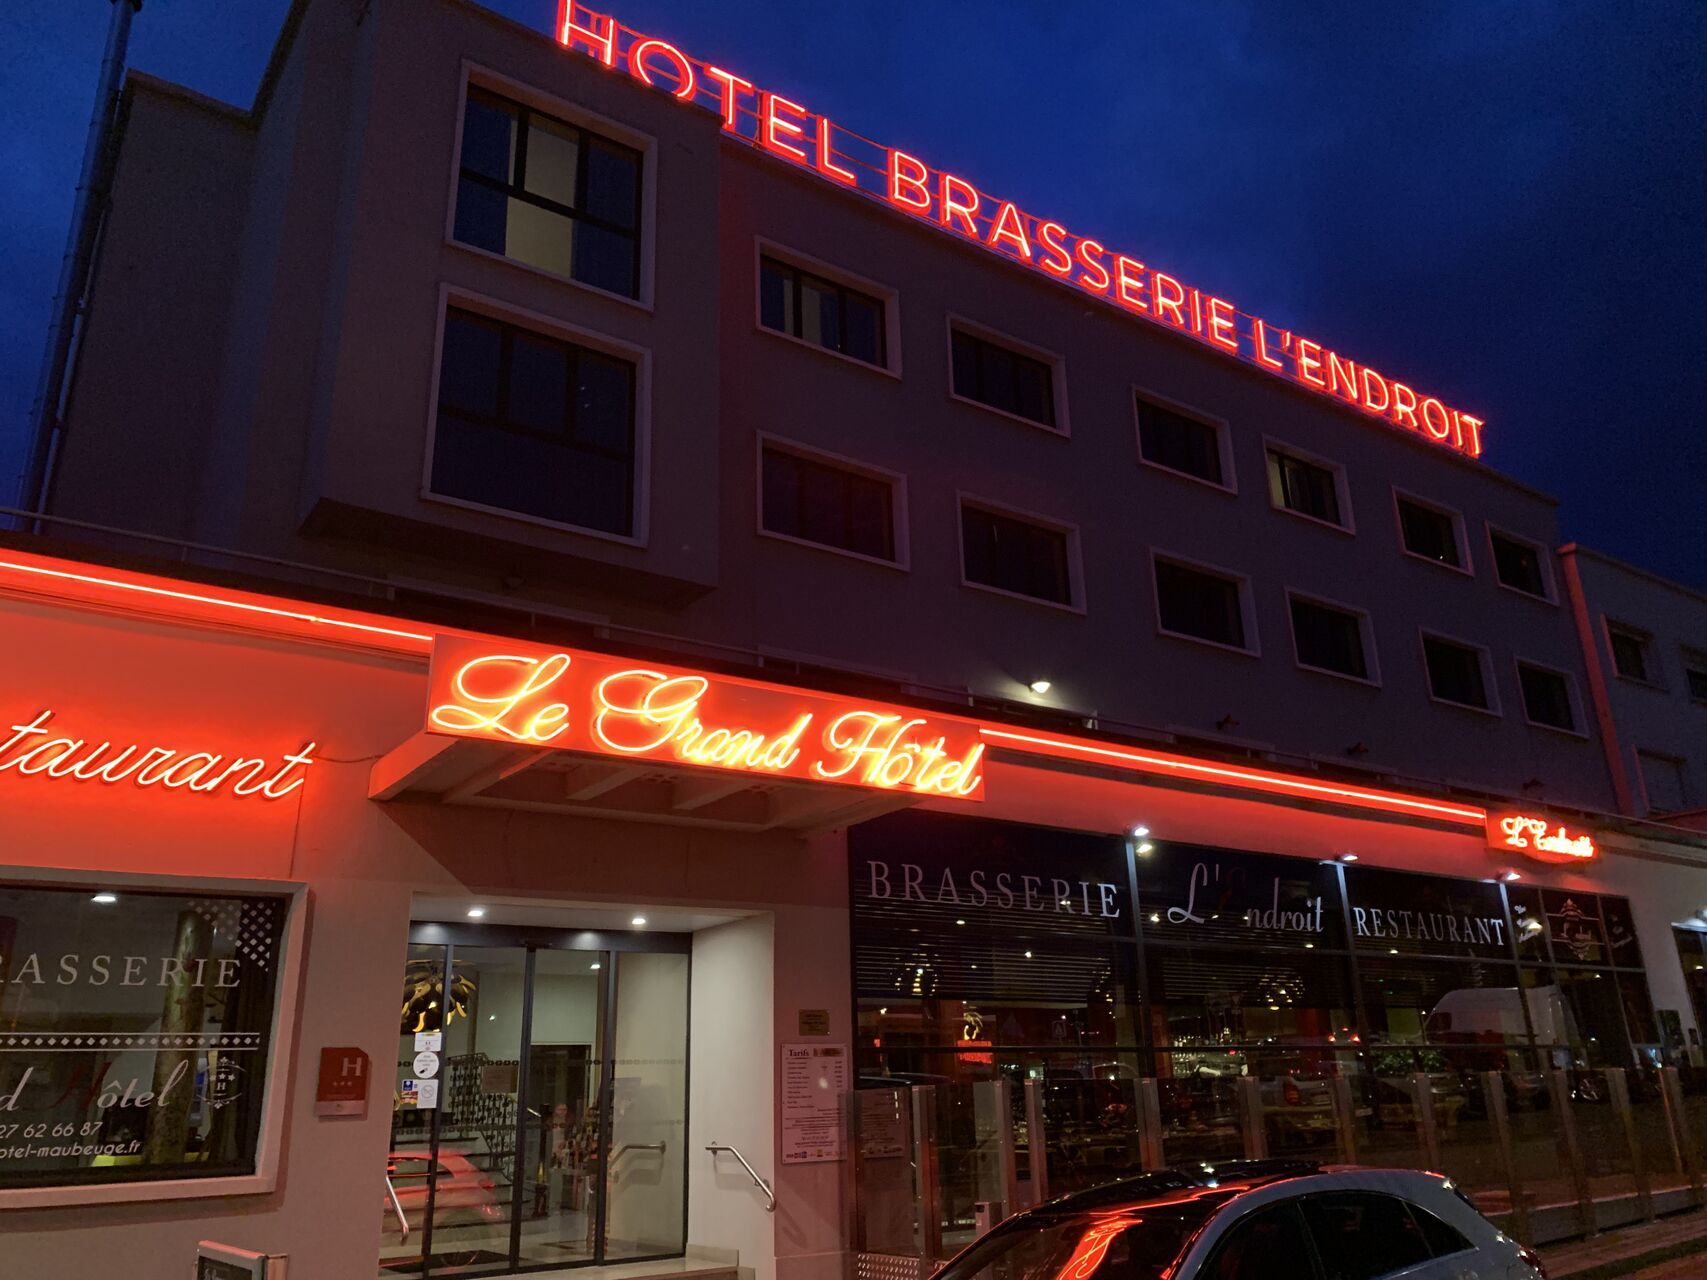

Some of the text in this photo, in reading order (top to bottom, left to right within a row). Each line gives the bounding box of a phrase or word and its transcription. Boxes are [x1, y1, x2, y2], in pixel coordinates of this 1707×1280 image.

[556, 0, 1484, 459] HOTEL BRASSERIE L'ENDROIT
[432, 653, 986, 795] Le Grand Hôtel
[866, 860, 1121, 919] BRASSERIE
[1167, 862, 1324, 932] L'ndroit
[1353, 907, 1505, 946] RESTAURANT
[0, 953, 242, 988] ASSERIE
[341, 1057, 363, 1076] H
[23, 1123, 48, 1139] 62
[51, 1122, 75, 1138] 66
[79, 1121, 104, 1137] 87
